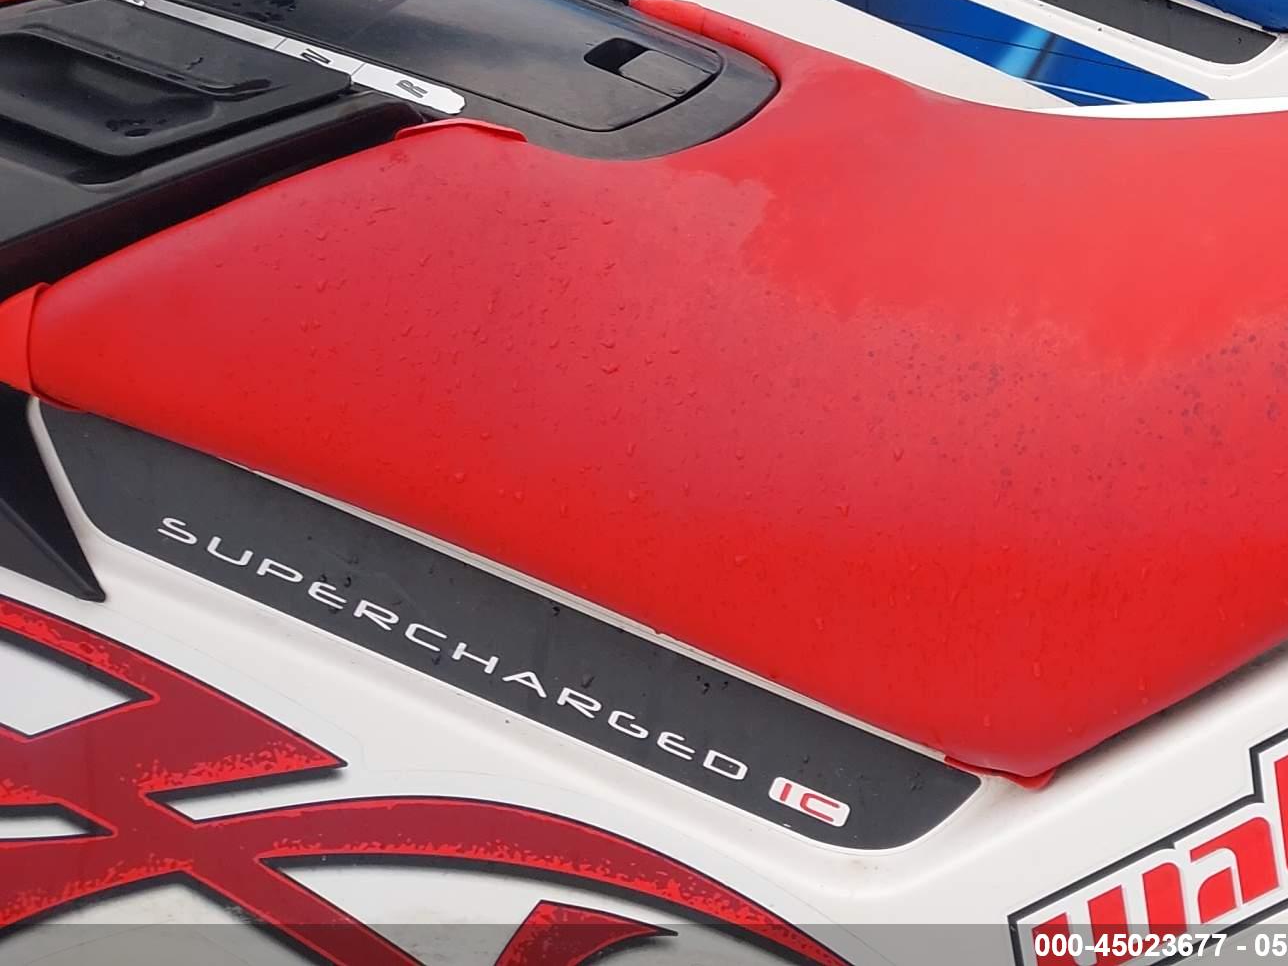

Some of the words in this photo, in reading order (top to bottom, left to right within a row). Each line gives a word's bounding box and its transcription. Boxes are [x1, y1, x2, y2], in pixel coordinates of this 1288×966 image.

[396, 79, 429, 99] R
[156, 516, 750, 783] SUPERCHARGED
[778, 781, 842, 824] IC
